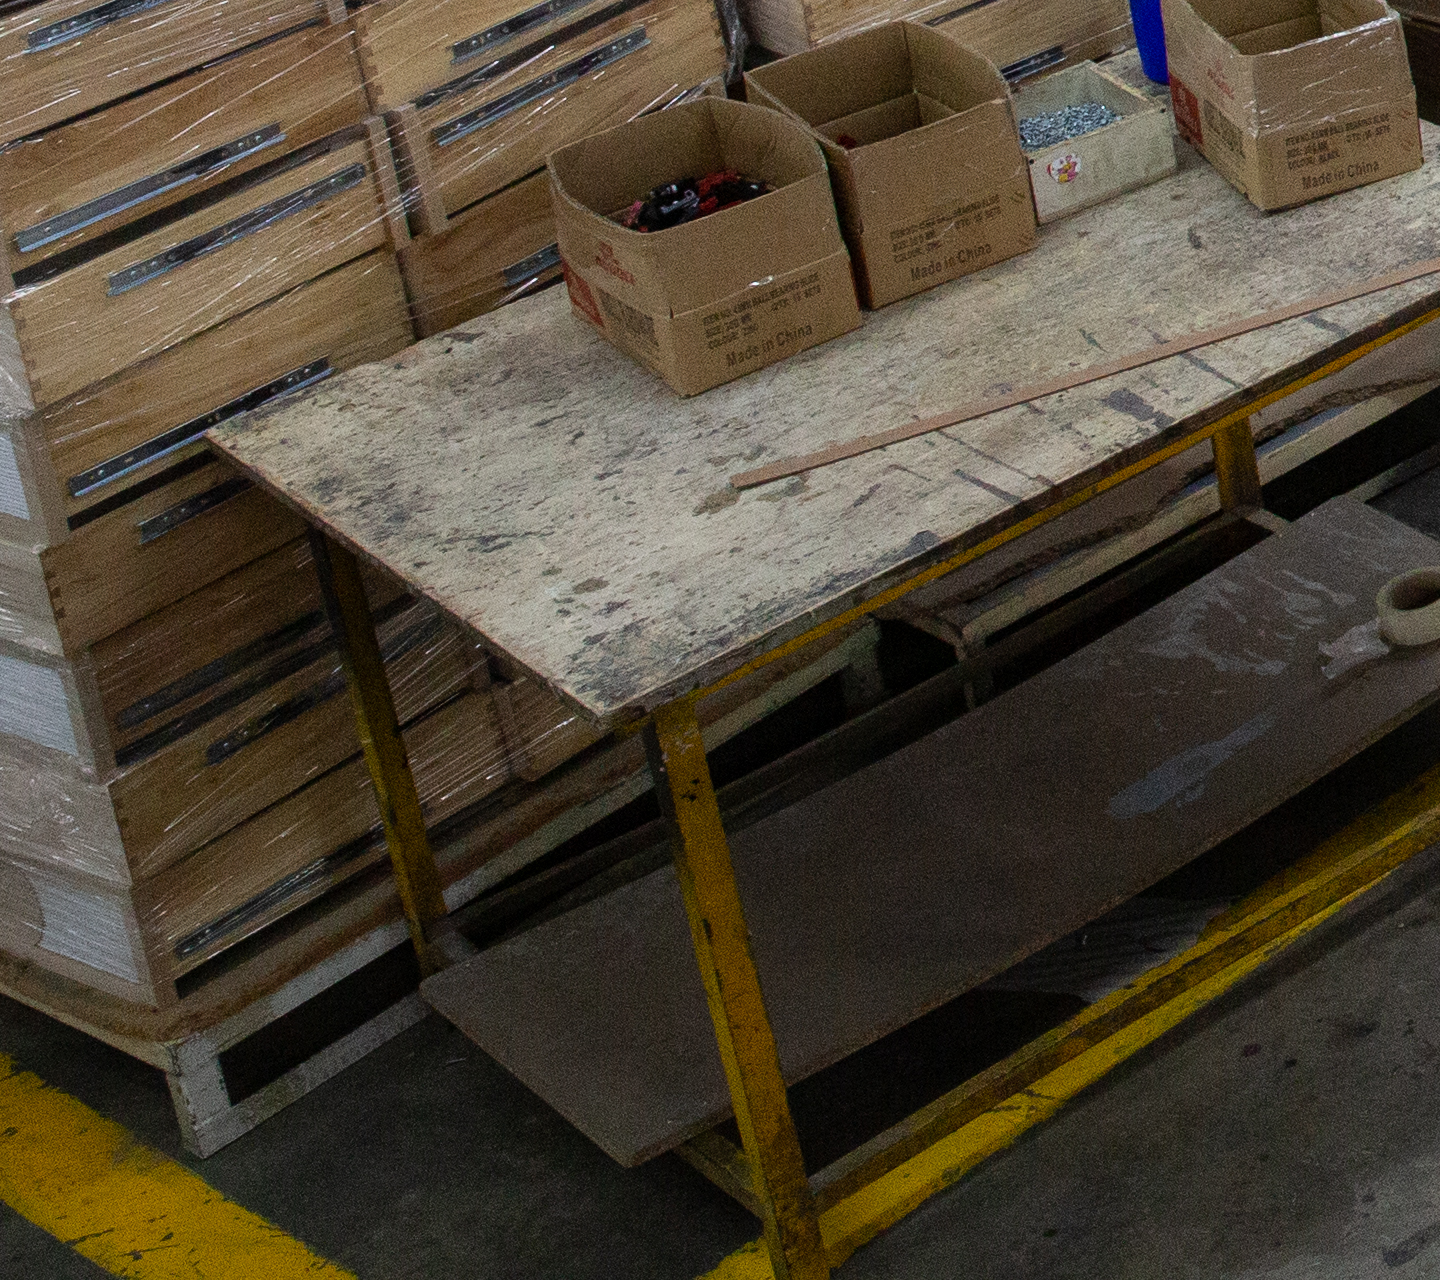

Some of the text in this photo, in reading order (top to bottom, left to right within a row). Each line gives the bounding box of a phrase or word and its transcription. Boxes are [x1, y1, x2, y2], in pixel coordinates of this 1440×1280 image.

[1302, 169, 1332, 191] Made
[1348, 157, 1379, 179] China
[910, 258, 942, 282] Made
[945, 253, 956, 268] in
[958, 240, 992, 264] China
[726, 322, 812, 367] Made in China
